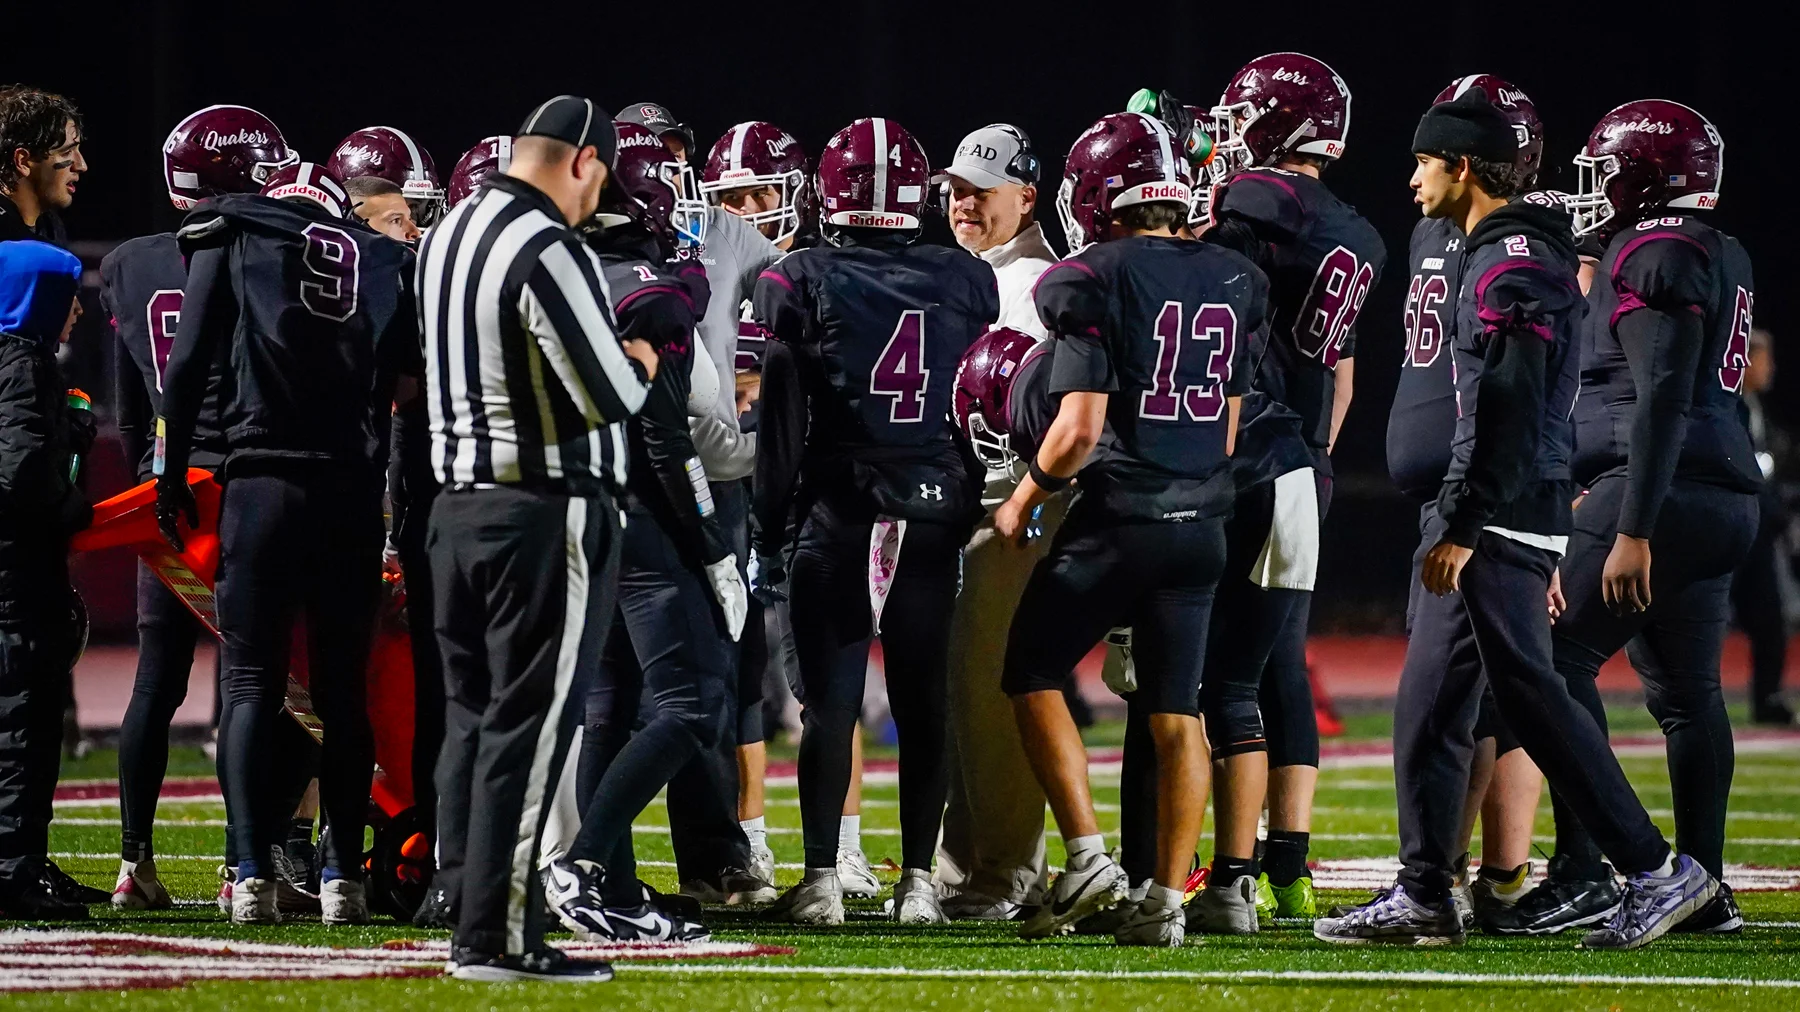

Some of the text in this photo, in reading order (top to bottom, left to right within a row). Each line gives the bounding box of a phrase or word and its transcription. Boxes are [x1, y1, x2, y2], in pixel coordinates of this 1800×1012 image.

[166, 131, 182, 153] 6
[204, 128, 269, 153] Quakers
[617, 132, 663, 149] uakers
[336, 141, 383, 166] Quakers
[888, 143, 902, 168] 4
[272, 185, 328, 203] Riddell
[1141, 185, 1189, 200] Riddell
[848, 214, 904, 227] Riddell
[1504, 234, 1530, 257] 2
[300, 221, 360, 323] 9
[632, 265, 659, 282] 1
[1291, 244, 1374, 371] 88
[1401, 274, 1449, 368] 66
[1718, 284, 1754, 396] 6
[869, 309, 930, 423] 4
[1139, 300, 1237, 422] 13
